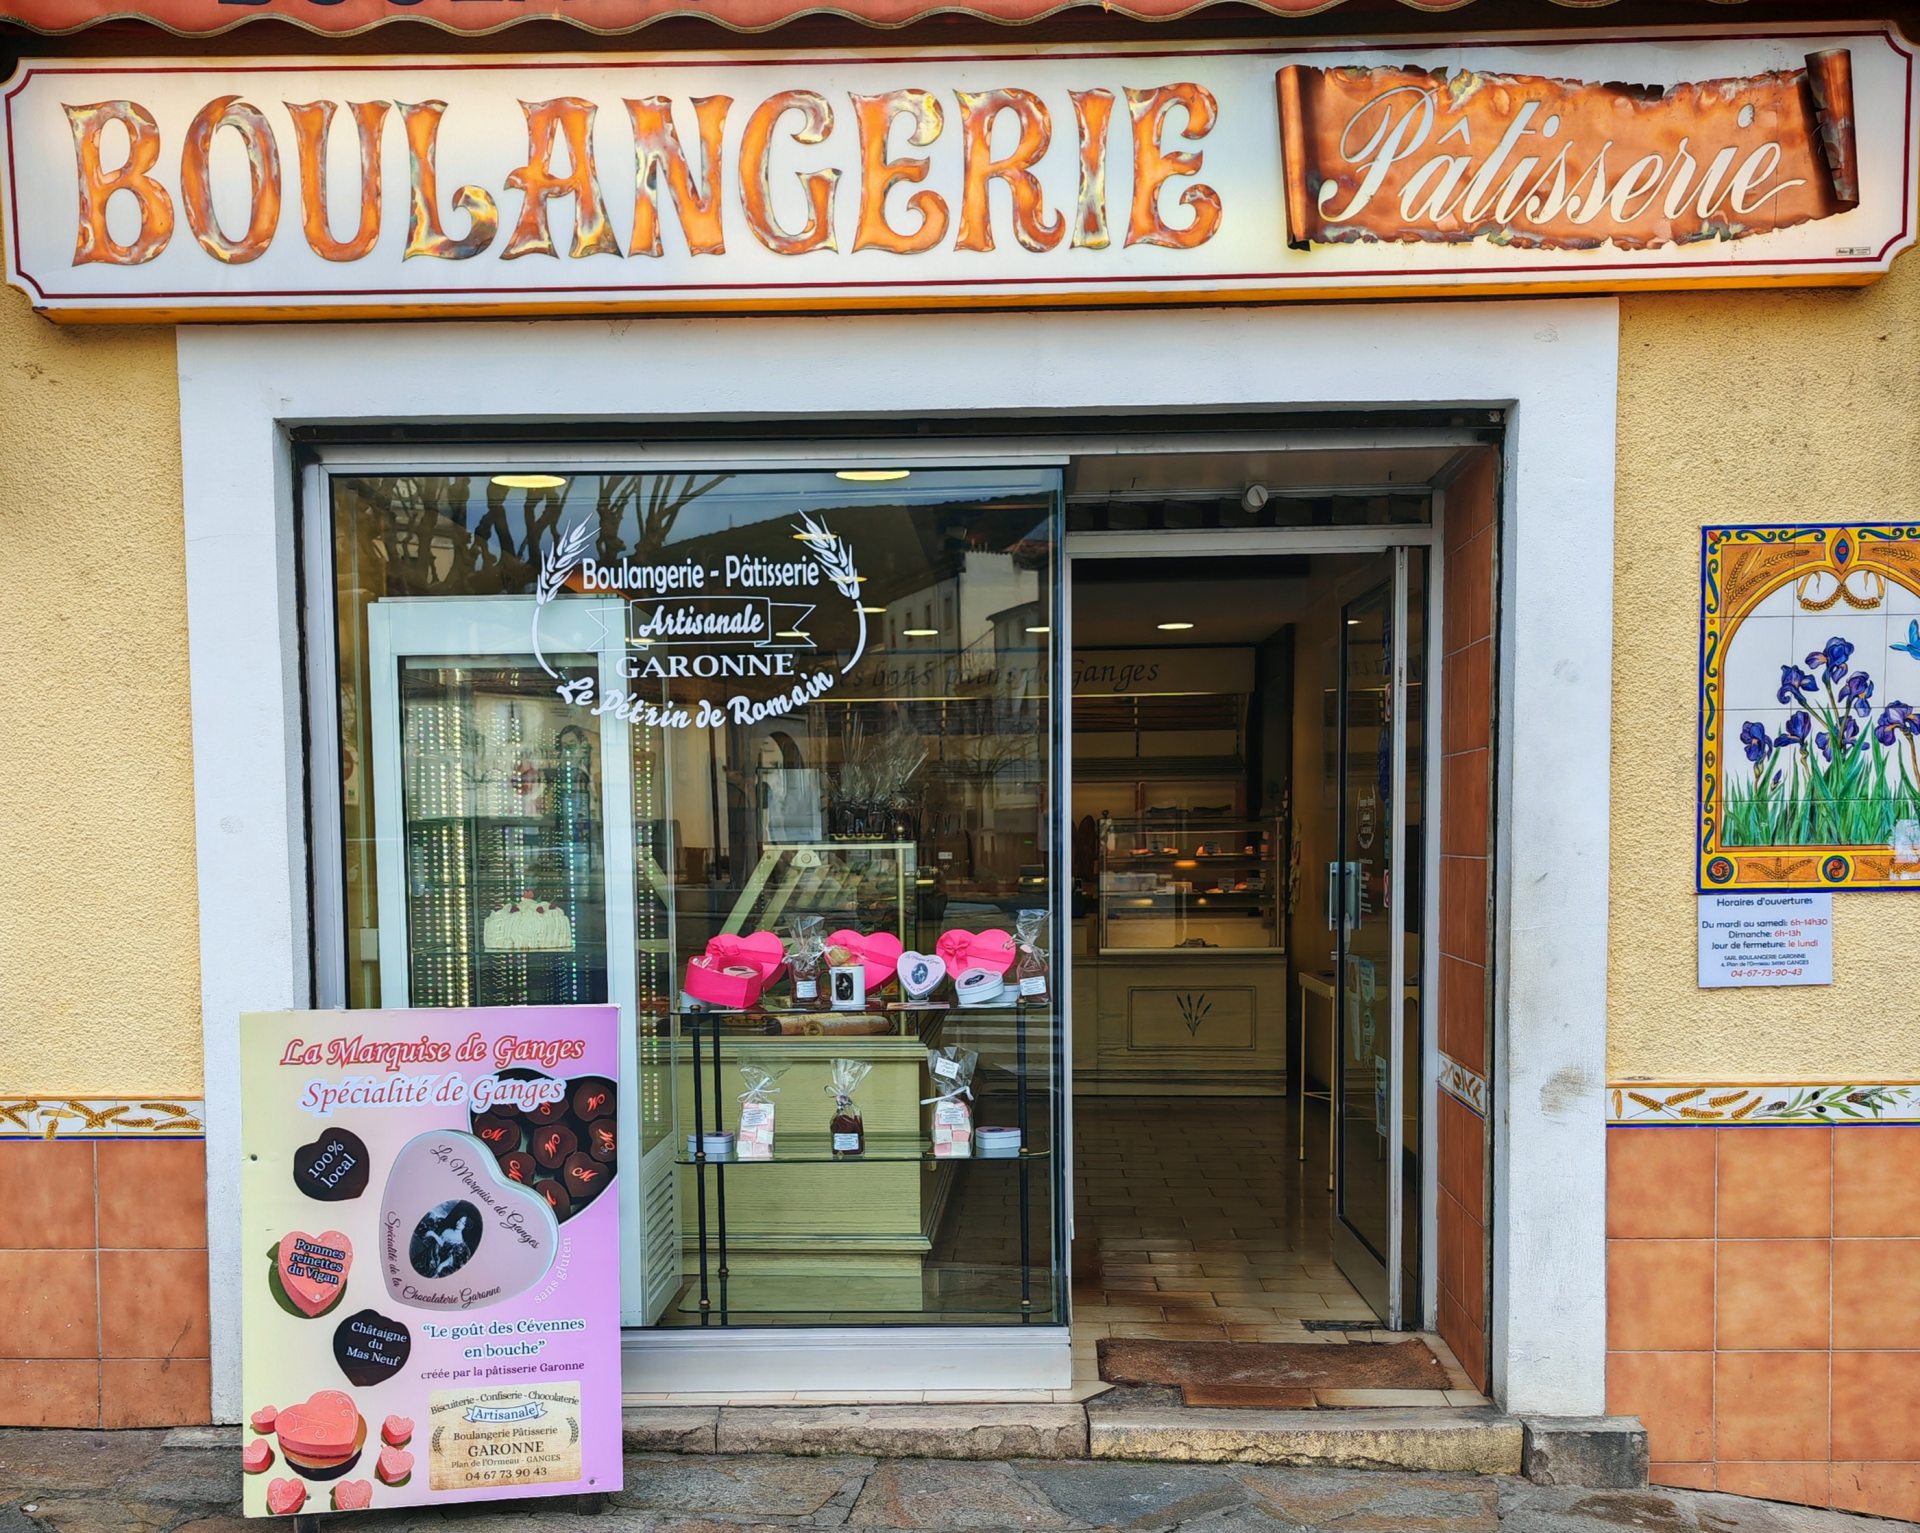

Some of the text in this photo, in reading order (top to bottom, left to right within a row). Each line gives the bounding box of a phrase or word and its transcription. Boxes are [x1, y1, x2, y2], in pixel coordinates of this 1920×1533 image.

[1318, 86, 1807, 225] Pâtisserie
[61, 82, 1223, 266] BOULANGERIE
[582, 557, 704, 593] Boulangerie
[725, 554, 819, 587] Pâtisserie
[639, 604, 764, 637] Artisanale
[615, 654, 795, 679] GARONNE
[556, 671, 835, 728] Le Pétrin de Romain
[1716, 897, 1813, 907] Horaires d'ouvertures
[1702, 920, 1714, 929] Du
[1716, 919, 1741, 928] mardi
[1790, 918, 1828, 926] 6h-14h30
[1728, 929, 1801, 939] Dimanche: 6h-13h
[1711, 941, 1728, 950] Jour
[1730, 941, 1741, 949] de
[1743, 940, 1786, 949] fermeture:
[1797, 939, 1818, 947] lundi
[1730, 968, 1803, 977] 04-67-73-90-43
[280, 1032, 585, 1072] La Marquise de Ganges
[302, 1076, 428, 1113] Spécialité
[435, 1076, 463, 1101] de
[473, 1078, 562, 1109] Ganges
[307, 1140, 344, 1178] 100%
[320, 1152, 356, 1189] local
[430, 1144, 540, 1250] La Marquise de Ganges
[295, 1239, 345, 1260] Pommes
[384, 1211, 401, 1288] Spécialité de la
[556, 1236, 572, 1281] gluten
[291, 1252, 343, 1272] reinettes
[288, 1263, 339, 1284] du Vigan
[402, 1284, 501, 1309] Chocolaterie Garonne
[351, 1321, 408, 1342] Châtaigne
[423, 1319, 585, 1340] “Le goût des Cévennes
[367, 1338, 383, 1351] du
[464, 1340, 545, 1358] en bouche”
[346, 1346, 401, 1366] Mas Neuf
[420, 1362, 585, 1380] créée par la pâtisserie Garonne
[430, 1396, 474, 1415] Biscuiterie
[480, 1390, 522, 1402] Confiserie
[528, 1390, 579, 1406] Chocolaterie
[474, 1405, 536, 1420] Artisanale
[453, 1424, 558, 1441] Boulangerie Pâtisserie
[468, 1440, 544, 1457] GARONNE
[451, 1460, 469, 1469] Plan
[470, 1459, 480, 1468] de
[482, 1457, 519, 1467] l'Ormeau
[526, 1453, 561, 1464] GANGES
[465, 1466, 548, 1482] 04 67 73 90 43
